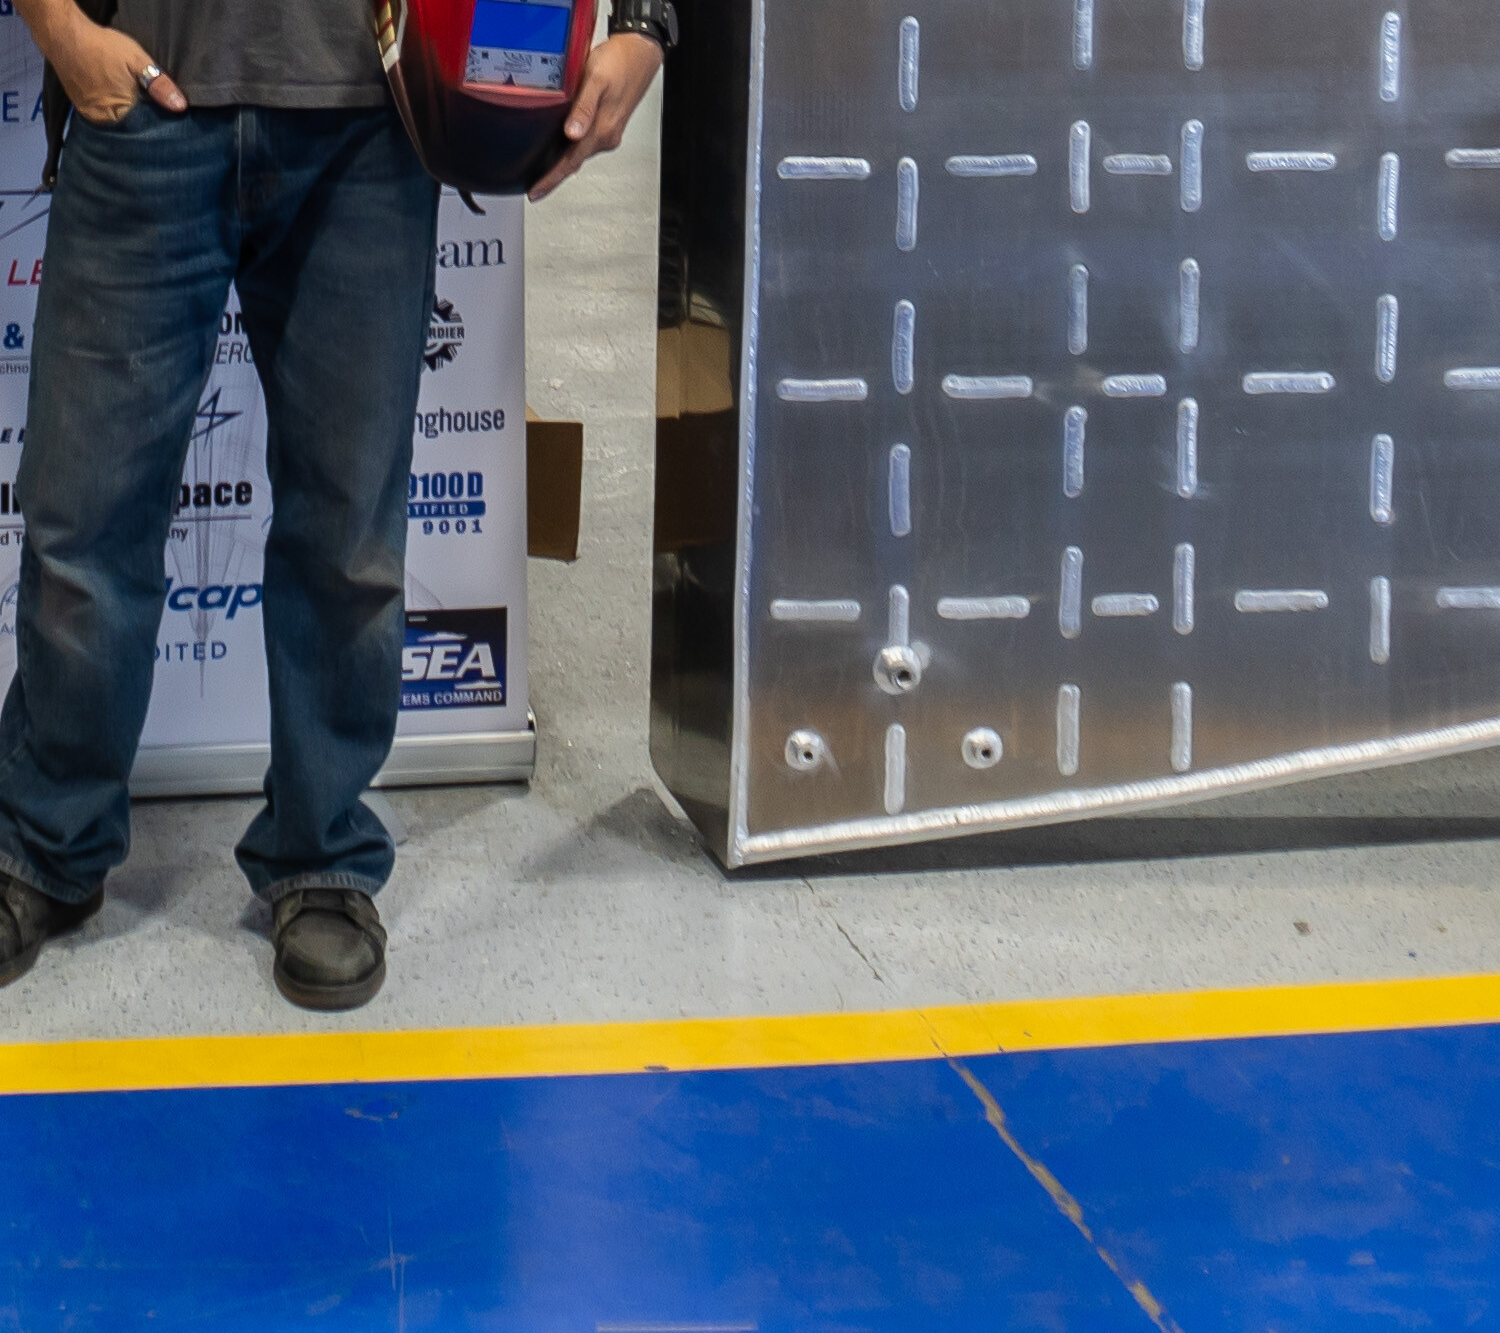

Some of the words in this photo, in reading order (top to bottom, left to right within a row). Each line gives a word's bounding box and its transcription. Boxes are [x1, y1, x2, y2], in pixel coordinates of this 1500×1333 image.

[3, 322, 26, 351] &
[412, 405, 506, 439] nghouse
[422, 518, 484, 535] 9001
[401, 642, 498, 681] SEA
[434, 690, 503, 705] COMMAND
